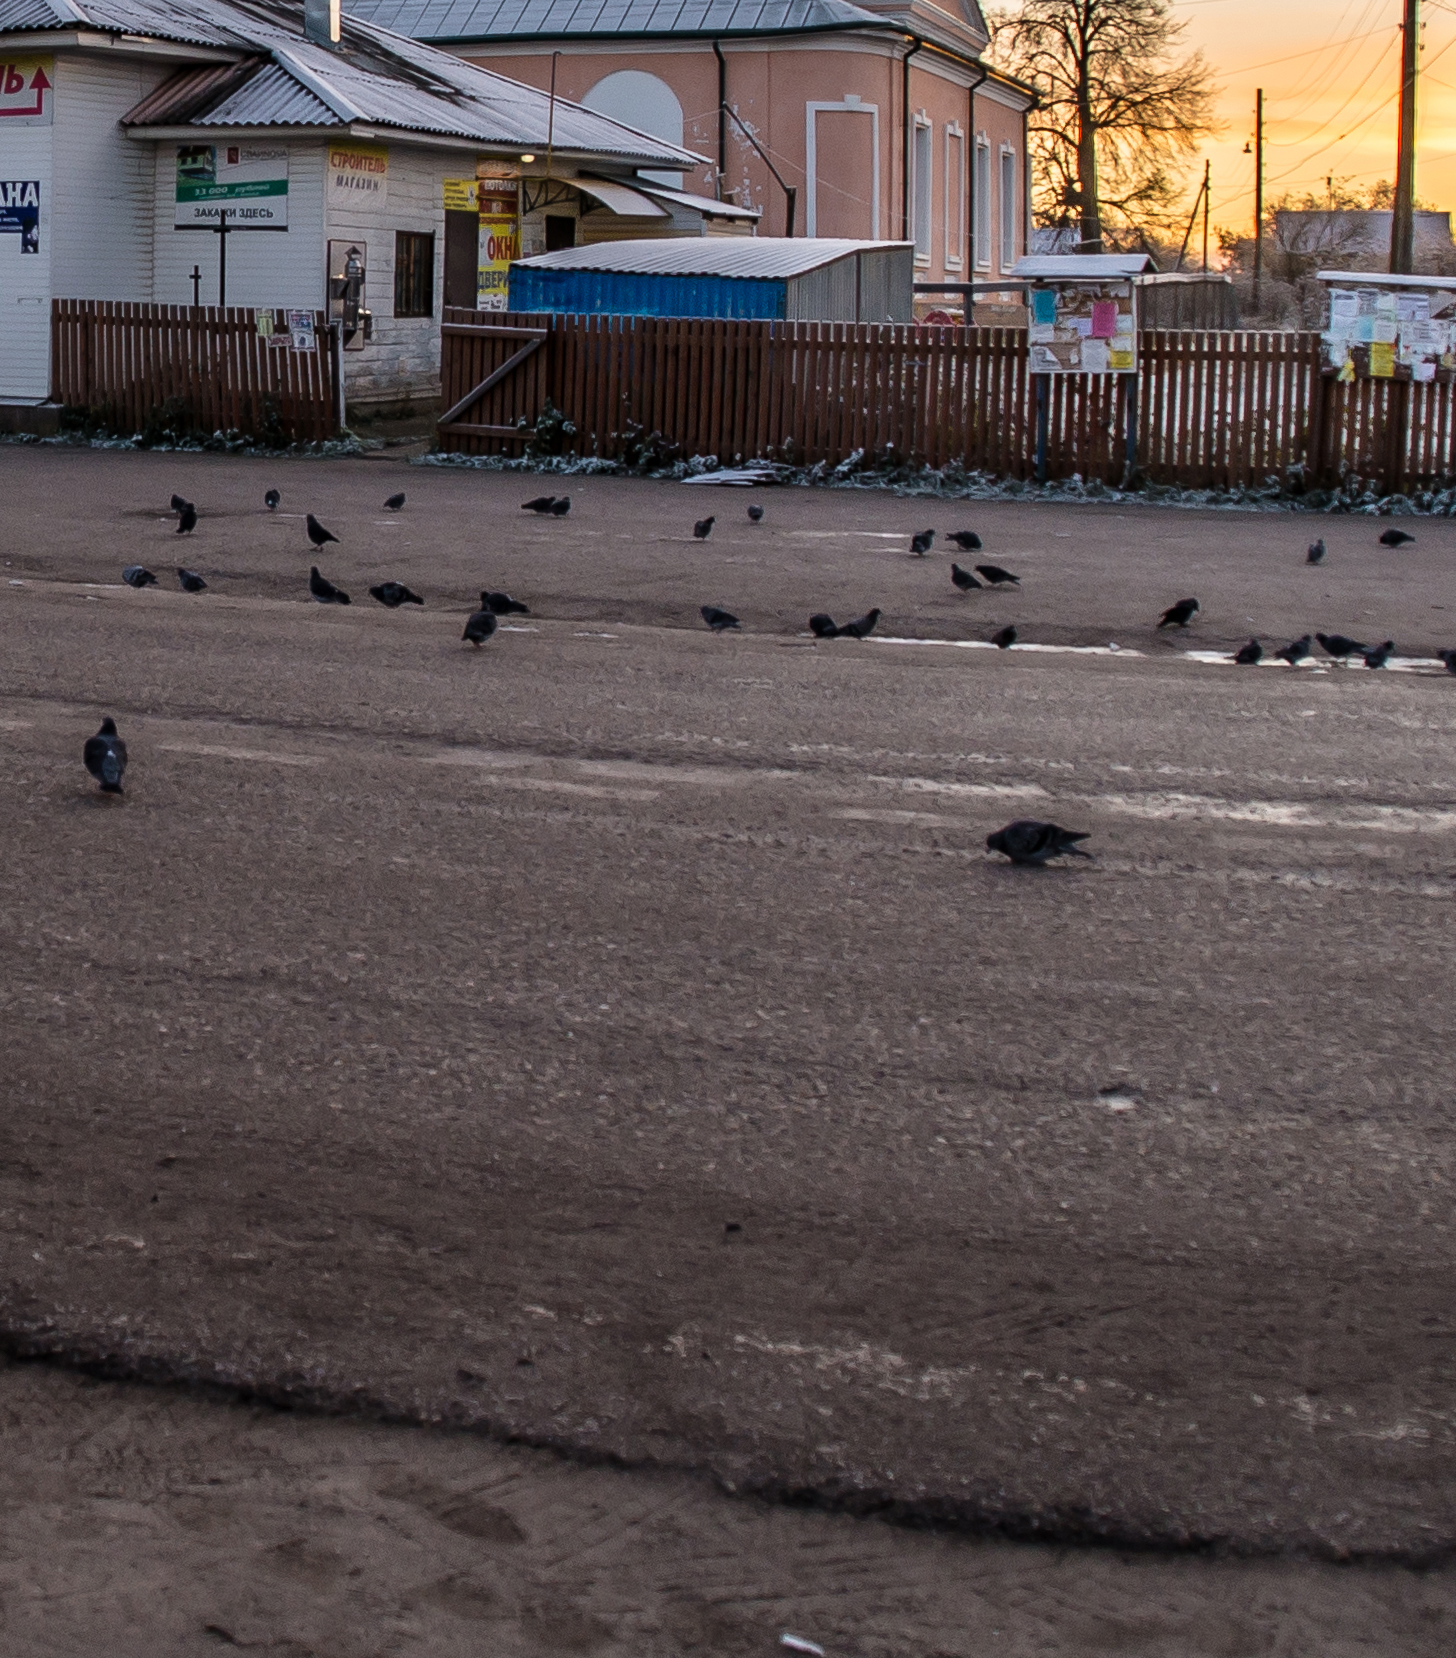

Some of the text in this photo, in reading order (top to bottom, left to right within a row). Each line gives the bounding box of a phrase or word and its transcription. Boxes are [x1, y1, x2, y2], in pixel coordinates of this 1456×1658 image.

[330, 151, 386, 174] СТРОИТЕЛЬ
[336, 174, 379, 192] МАГАЗИН
[238, 207, 274, 220] ЗДЕСЬ
